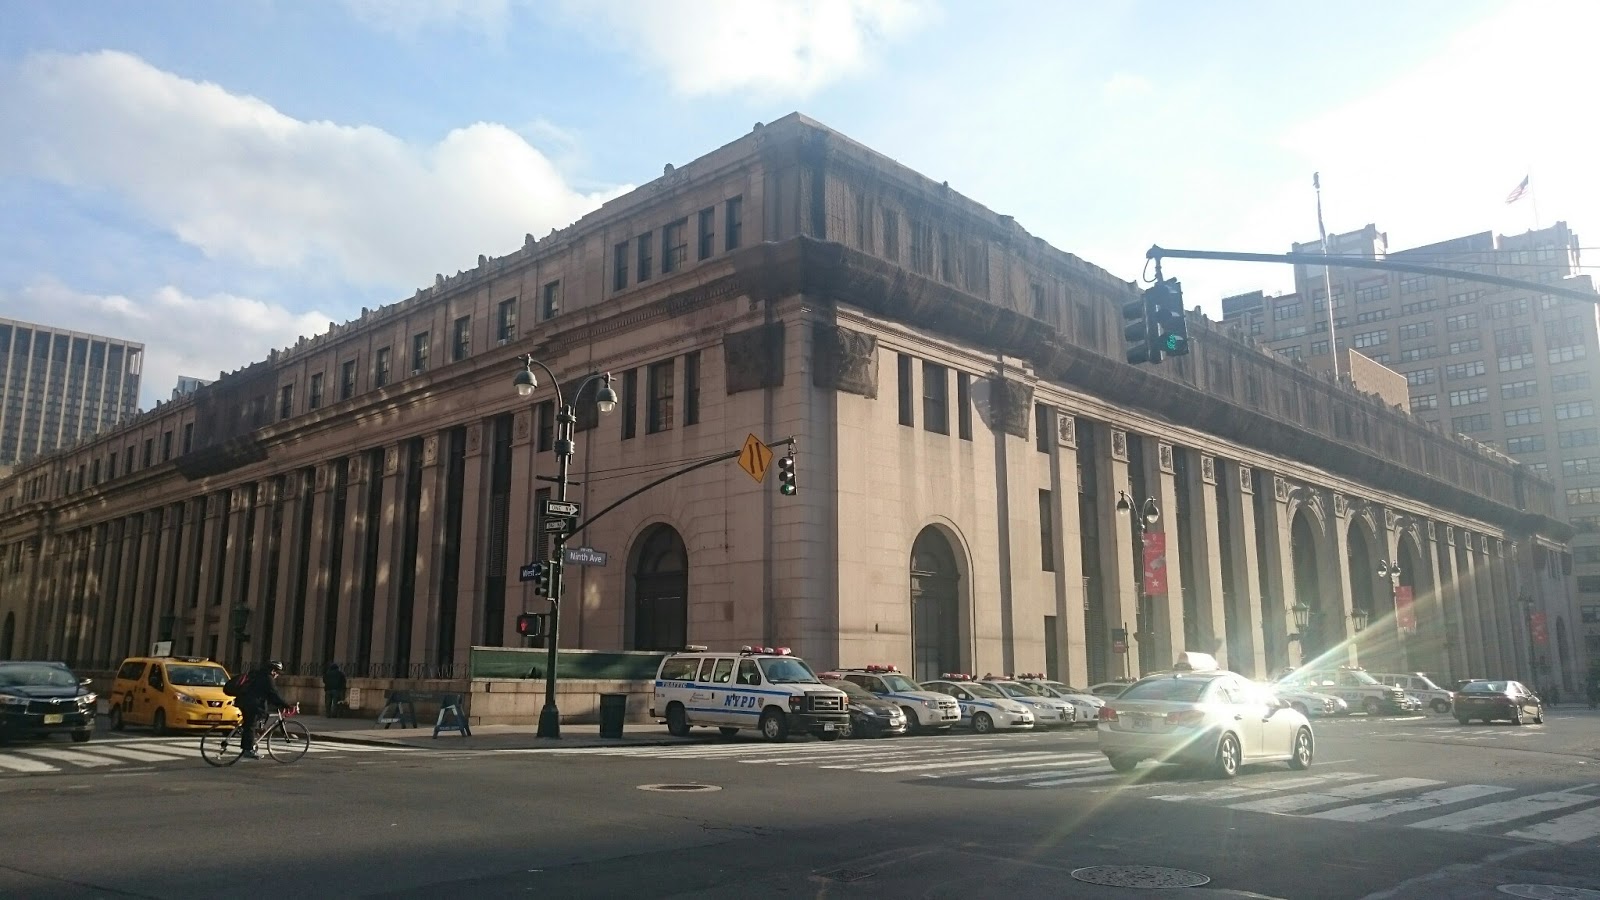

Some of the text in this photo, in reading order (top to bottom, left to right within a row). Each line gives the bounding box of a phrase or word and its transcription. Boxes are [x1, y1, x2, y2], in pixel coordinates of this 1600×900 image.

[570, 552, 602, 563] Ninth Ave
[662, 681, 687, 689] TRAFFIC
[724, 694, 756, 708] NYPD
